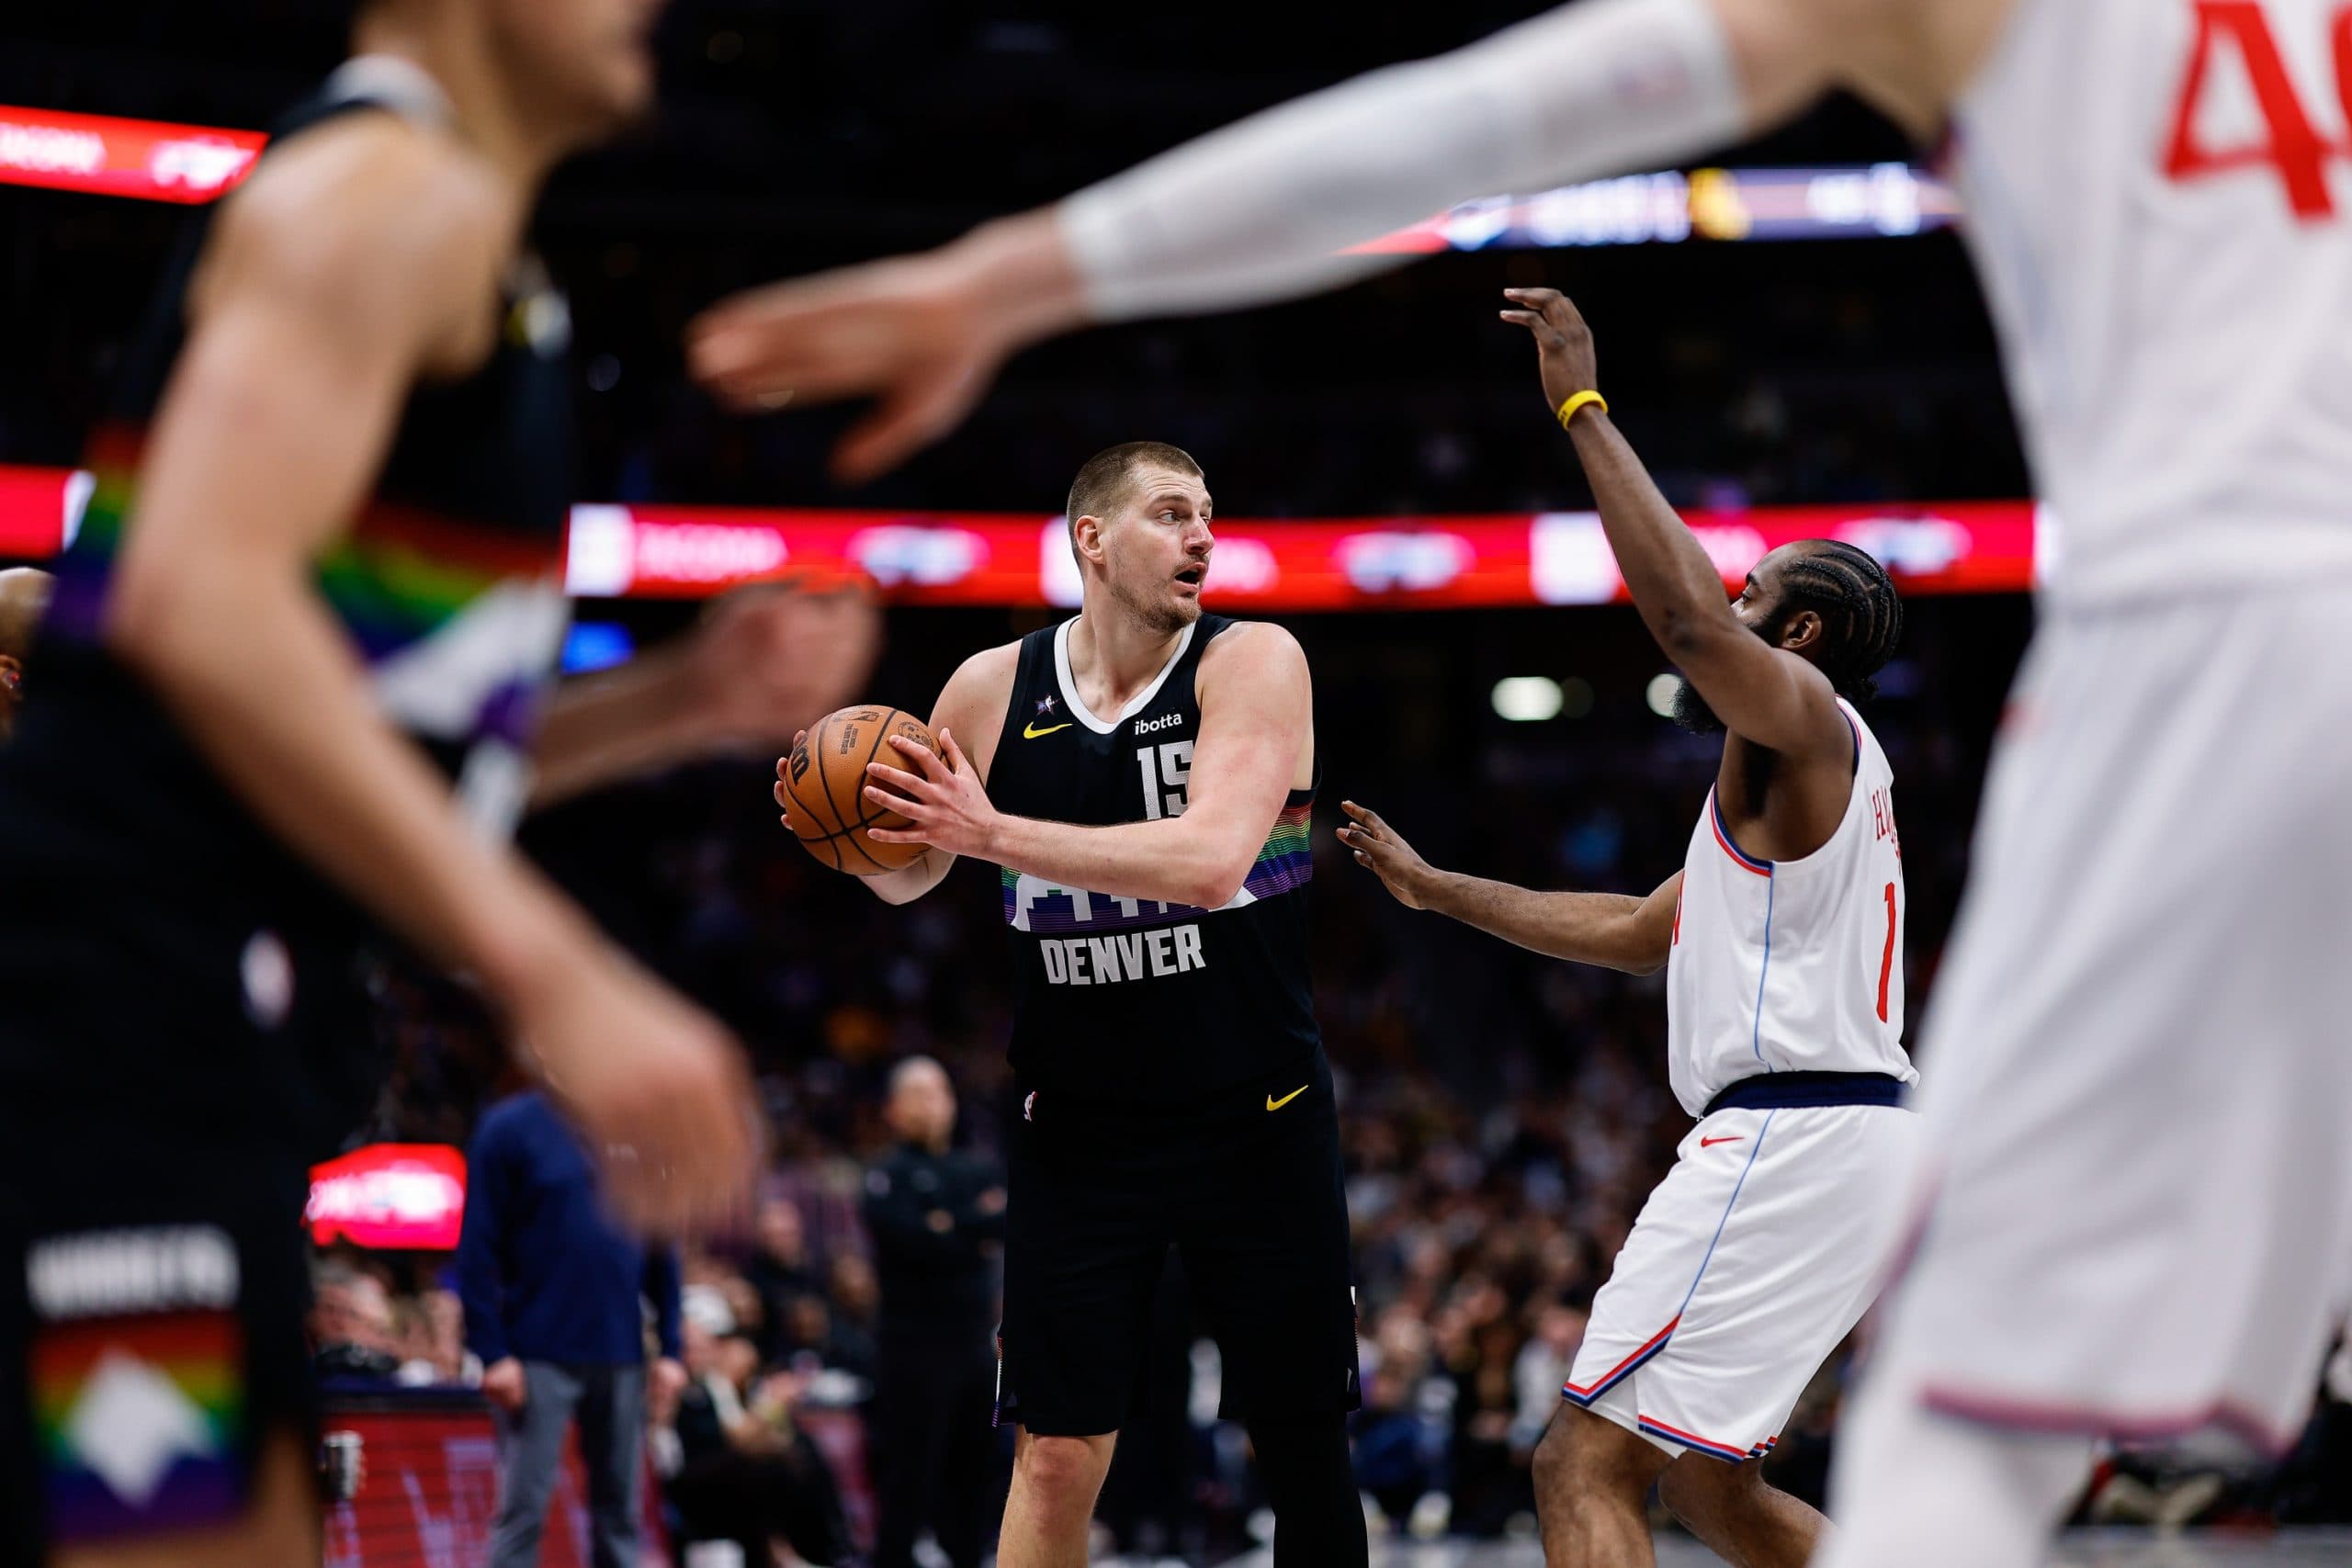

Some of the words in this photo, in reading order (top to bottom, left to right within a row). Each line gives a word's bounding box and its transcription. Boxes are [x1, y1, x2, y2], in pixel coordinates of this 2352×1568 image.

[1135, 713, 1183, 736] ibotta
[1137, 739, 1193, 820] 15
[1040, 923, 1206, 986] DENVER
[1876, 881, 1896, 1023] 1
